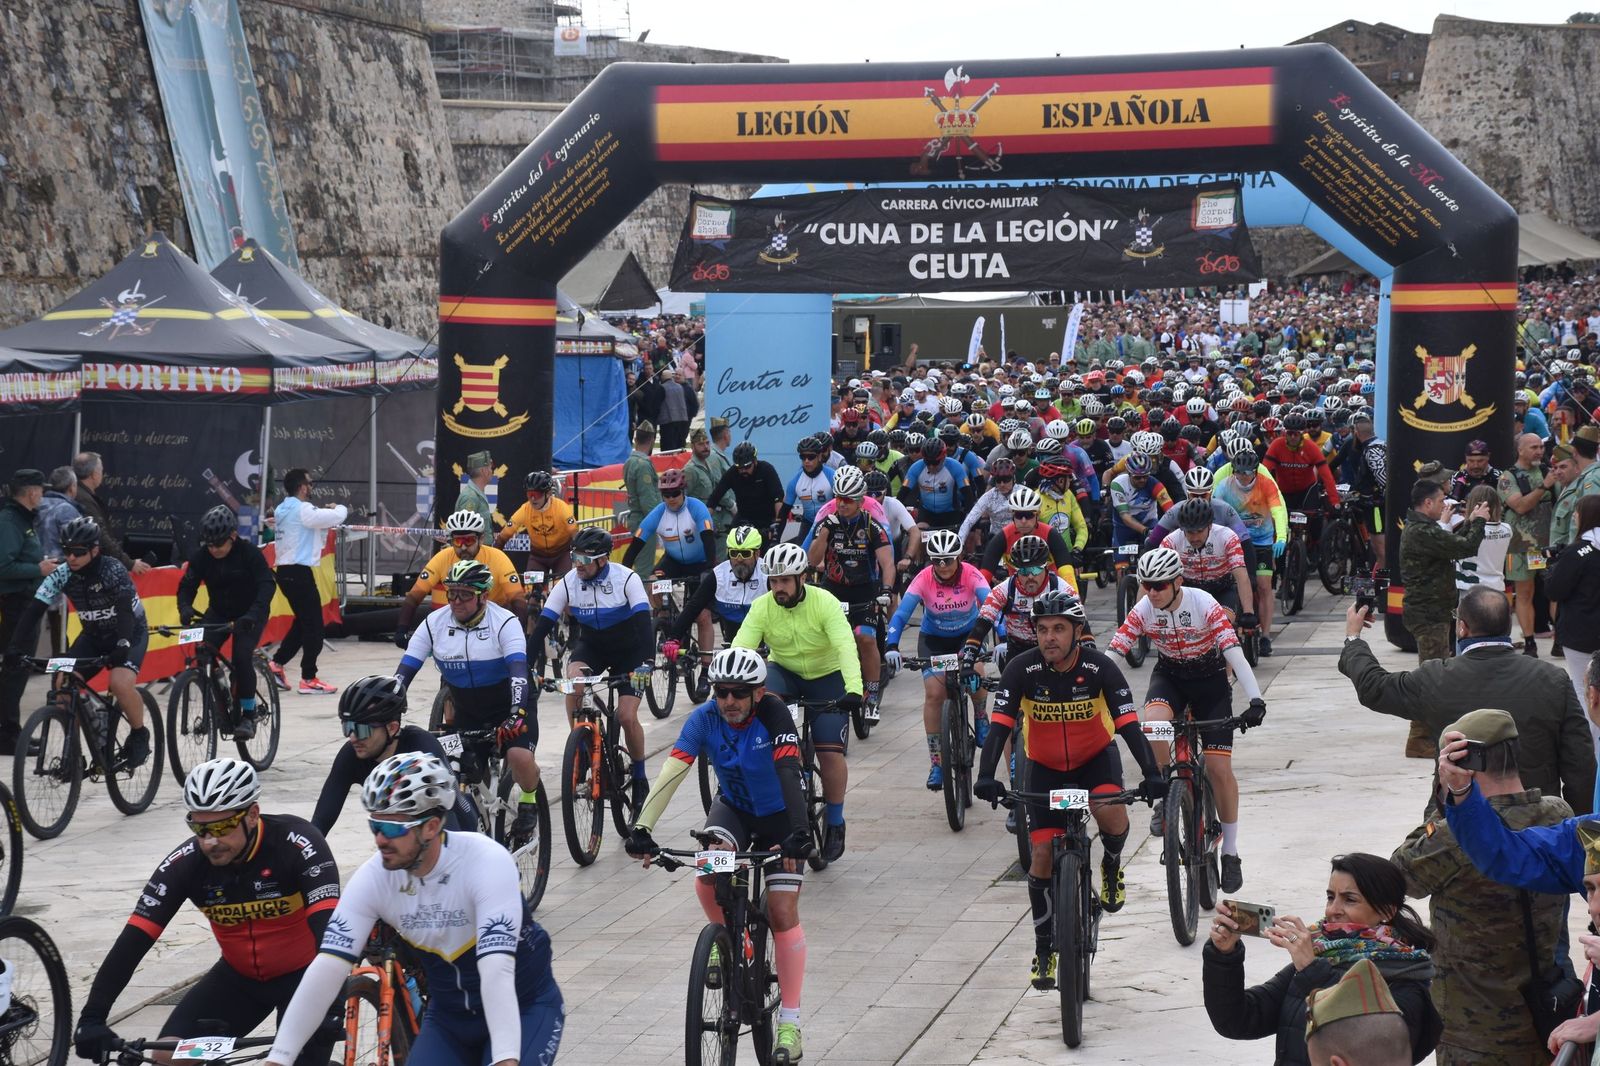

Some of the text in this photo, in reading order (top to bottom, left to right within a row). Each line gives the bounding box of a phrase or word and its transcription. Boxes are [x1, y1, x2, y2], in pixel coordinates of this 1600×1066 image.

[736, 94, 1211, 136] LEGIÓN ESPAÑOLA
[528, 162, 544, 186] del
[542, 113, 600, 168] Legionario
[1382, 144, 1400, 156] de
[1394, 154, 1412, 168] la
[1409, 163, 1460, 212] Muerte
[881, 196, 1038, 210] CARRERA CÍVICO-MILITAR
[911, 222, 943, 244] DE
[953, 221, 986, 243] LA
[908, 252, 1010, 279] CEUTA
[791, 372, 813, 388] es
[721, 402, 814, 441] Deporte
[932, 600, 968, 611] Agrobio
[1032, 702, 1094, 713] ANDALUCIA
[1032, 710, 1095, 721] NATURE
[1154, 727, 1172, 736] 396
[443, 740, 459, 749] 142
[1066, 795, 1085, 803] 124
[714, 856, 727, 866] 86
[203, 1042, 223, 1052] 32
